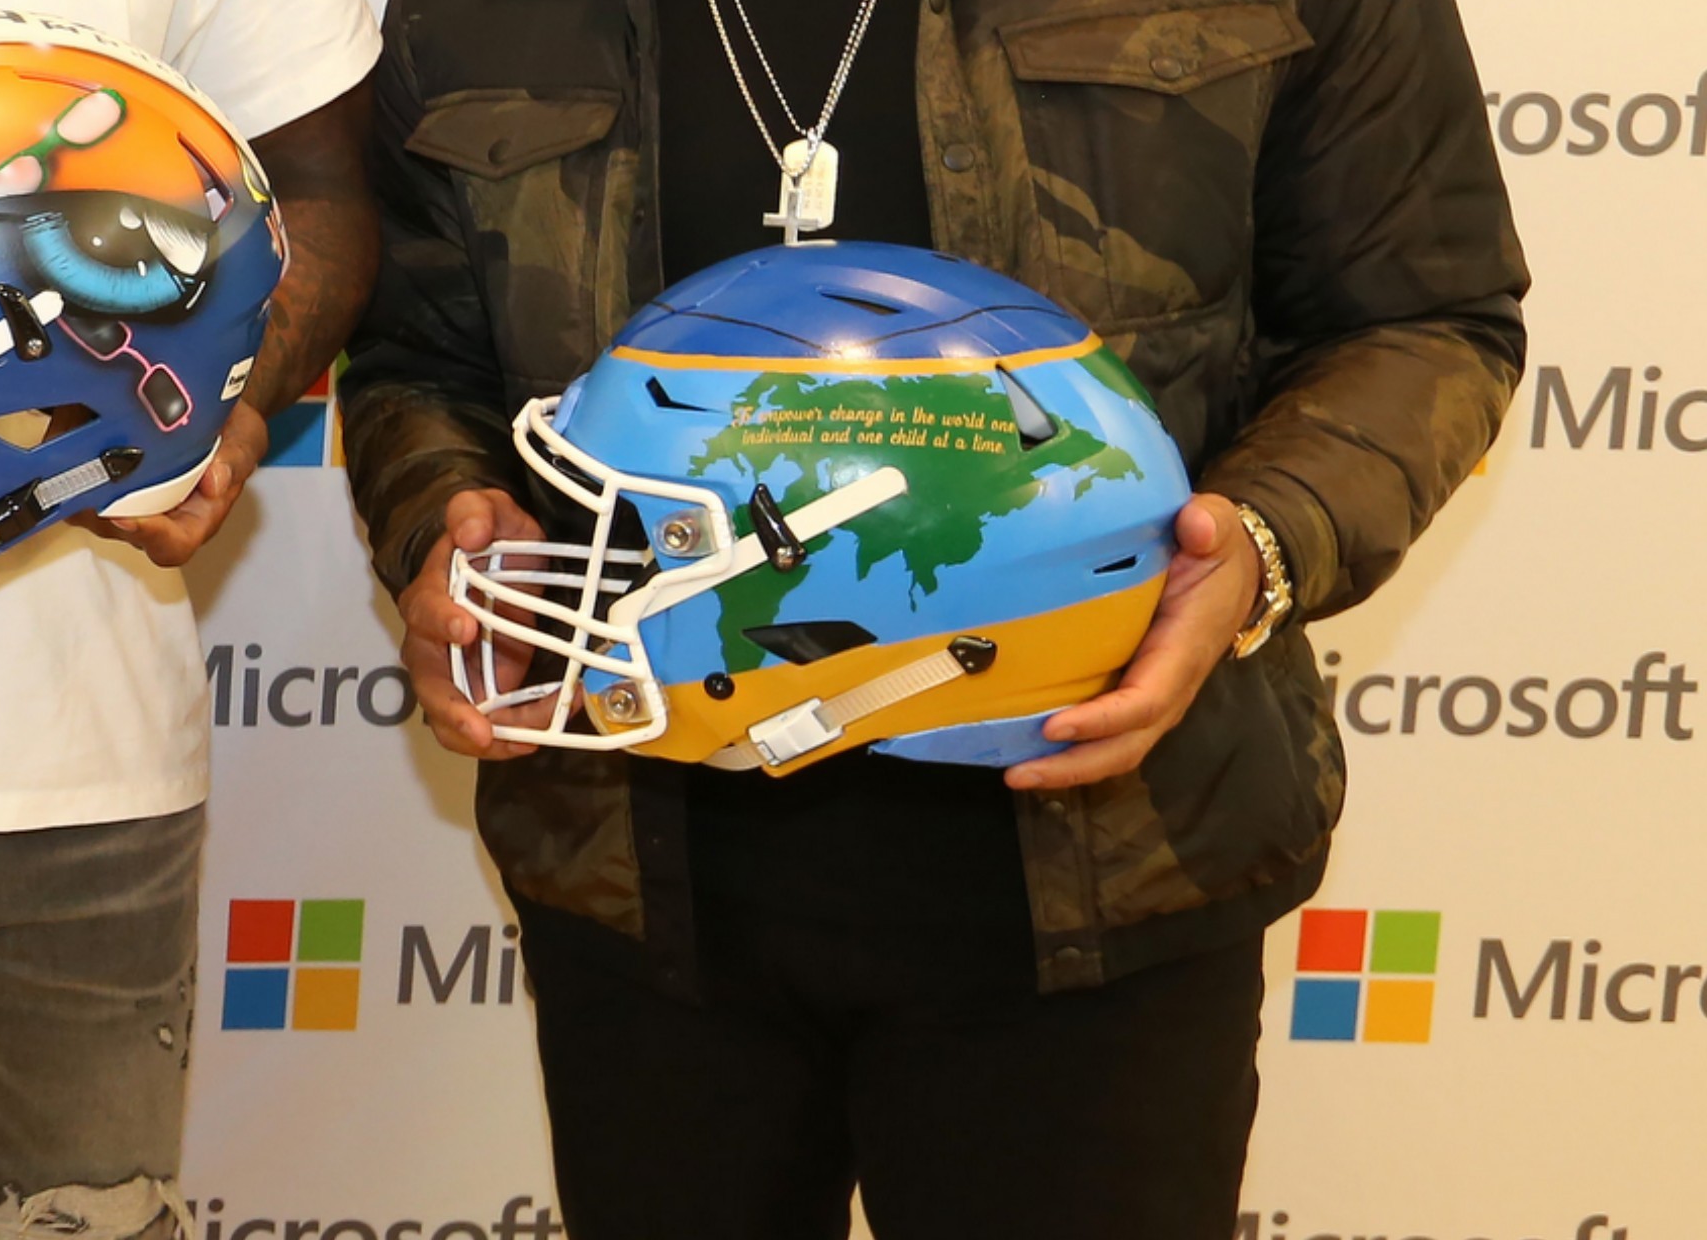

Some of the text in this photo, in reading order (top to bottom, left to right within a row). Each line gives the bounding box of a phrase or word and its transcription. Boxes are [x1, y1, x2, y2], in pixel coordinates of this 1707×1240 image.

[829, 405, 884, 428] change
[890, 407, 906, 423] in
[912, 406, 935, 425] the
[942, 411, 985, 429] world
[991, 419, 1017, 434] one
[742, 426, 814, 444] individual
[820, 426, 850, 444] and
[857, 430, 883, 445] one
[890, 428, 927, 447] child
[933, 431, 949, 448] at
[955, 436, 967, 450] a
[1325, 651, 1697, 742] icrosoft
